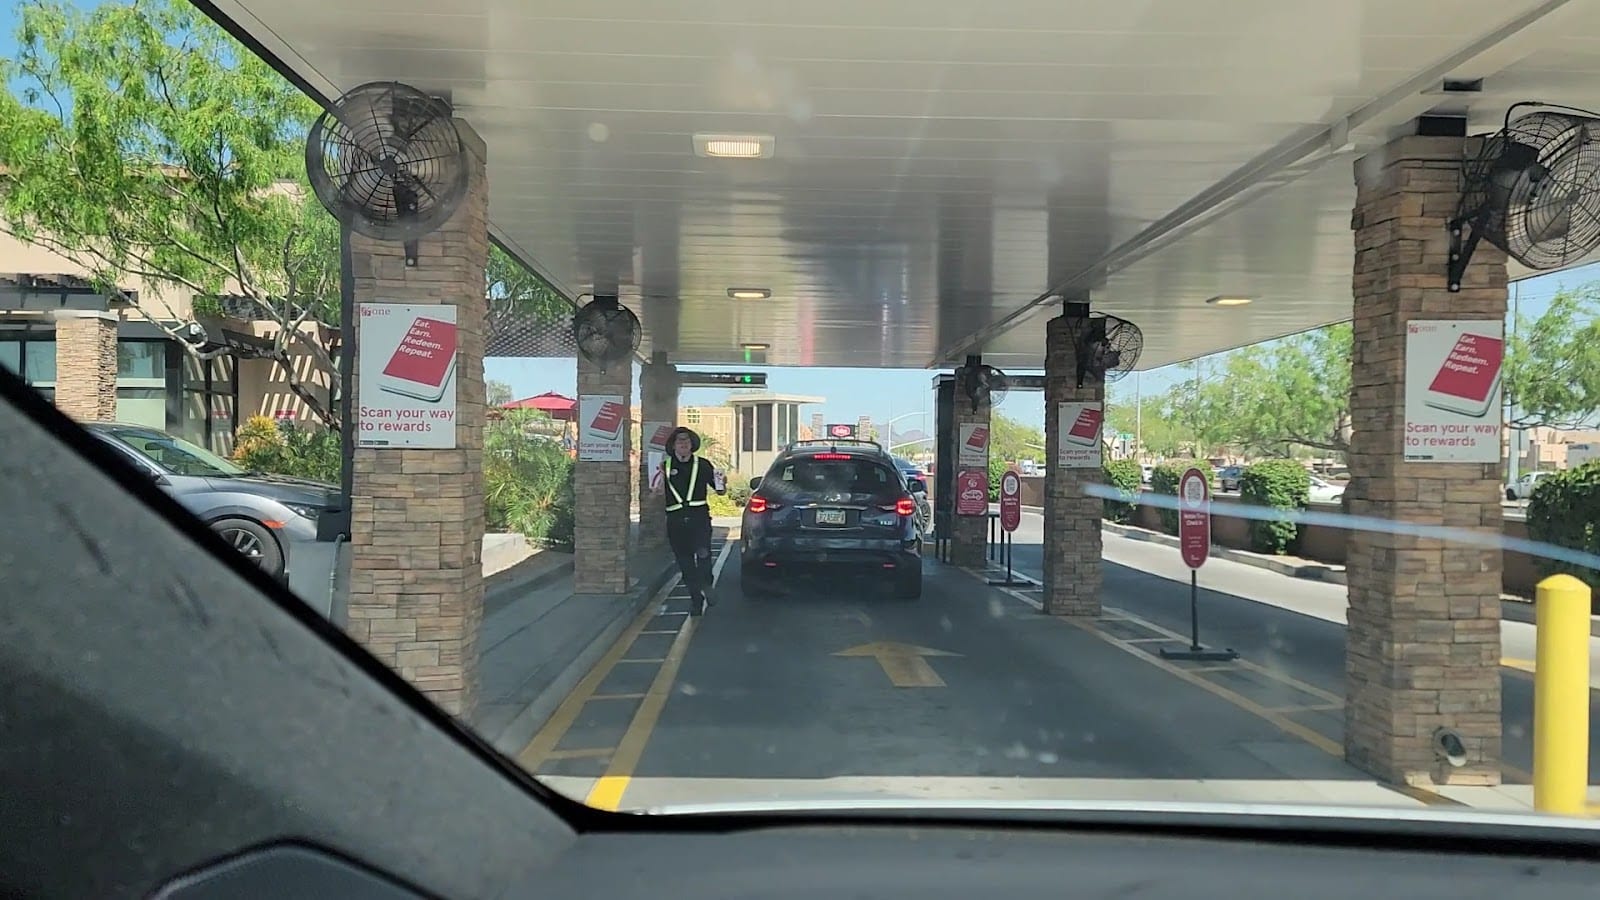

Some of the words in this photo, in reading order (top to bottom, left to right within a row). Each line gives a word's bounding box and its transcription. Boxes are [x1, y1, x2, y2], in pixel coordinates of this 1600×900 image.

[415, 319, 430, 328] Eat.
[409, 328, 432, 338] Earn.
[404, 336, 444, 350] Redeem.
[399, 344, 433, 358] Repeat.
[360, 406, 392, 418] Scan
[396, 409, 425, 420] your
[430, 410, 454, 421] way
[360, 420, 374, 431] to
[378, 420, 431, 432] rewards
[1407, 422, 1437, 433] Scan
[1441, 424, 1469, 435] your
[1475, 425, 1498, 436] way
[1406, 436, 1419, 446] to
[1424, 436, 1476, 447] rewards
